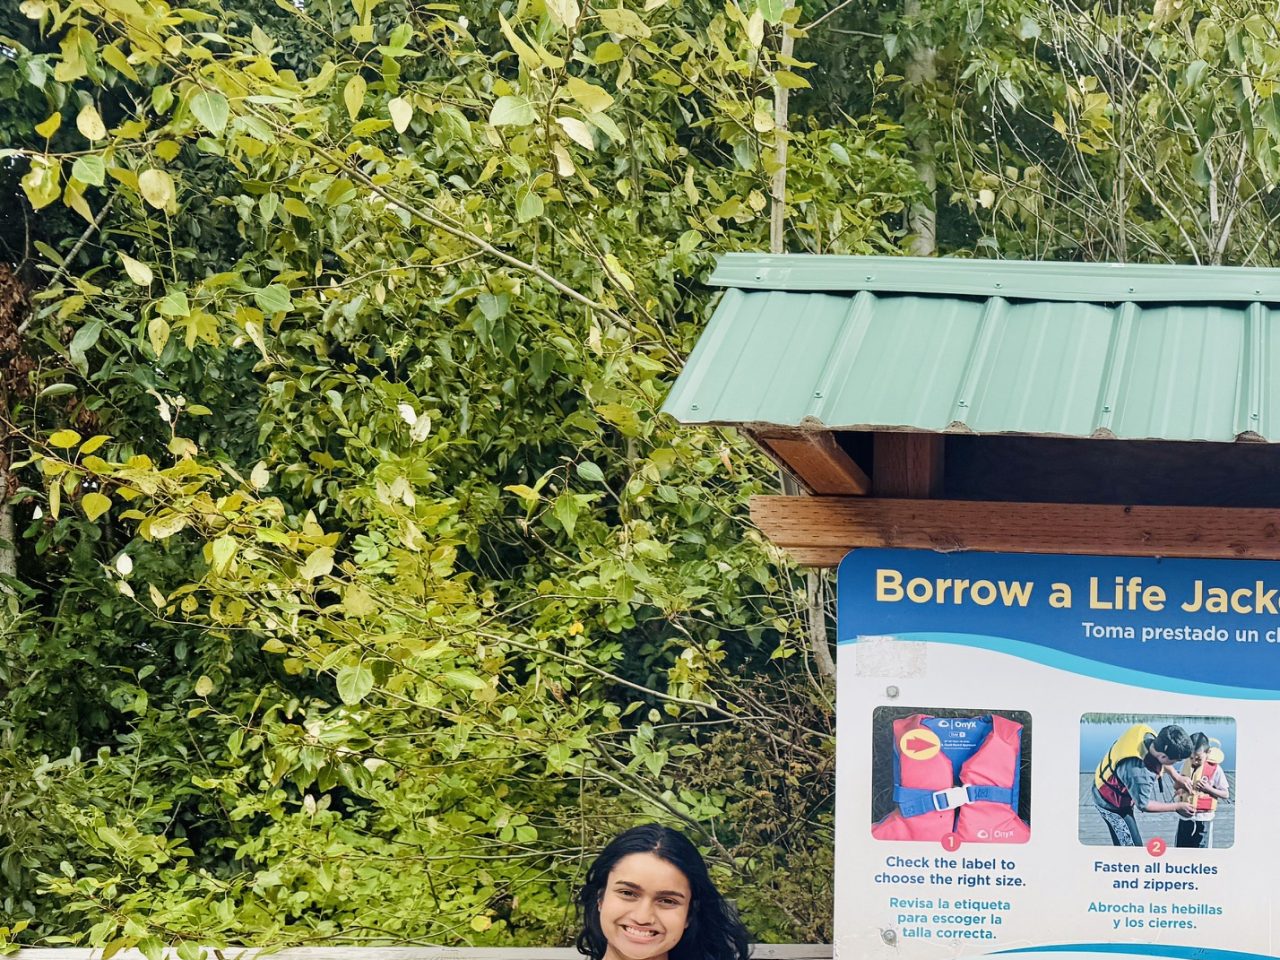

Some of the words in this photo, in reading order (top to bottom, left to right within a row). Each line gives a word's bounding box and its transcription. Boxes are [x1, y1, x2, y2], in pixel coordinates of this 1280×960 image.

[876, 569, 1033, 607] Borrow
[1049, 585, 1072, 609] a
[1090, 577, 1165, 612] Life
[1082, 622, 1135, 640] Toma
[1142, 625, 1229, 642] prestado
[1236, 629, 1259, 642] un
[954, 721, 976, 729] Onyx
[994, 829, 1014, 838] Onyx
[948, 836, 955, 847] 1
[1152, 841, 1161, 852] 2
[886, 857, 930, 869] Check
[935, 857, 957, 869] the
[962, 858, 996, 870] label
[1001, 860, 1015, 870] to
[1094, 862, 1140, 874] Fasten
[1144, 863, 1161, 873] all
[1165, 863, 1217, 875] buckles
[874, 873, 925, 885] choose
[930, 873, 954, 885] the
[958, 873, 991, 887] right
[996, 875, 1026, 887] size.
[1113, 879, 1139, 890] and
[1143, 878, 1199, 892] zippers.
[890, 898, 933, 910] Revisa
[938, 899, 949, 909] la
[954, 899, 1010, 913] etiqueta
[1088, 902, 1145, 914] Abrocha
[1149, 903, 1167, 914] las
[1171, 903, 1223, 915] hebillas
[898, 914, 928, 924] para
[932, 914, 986, 927] escoger
[991, 913, 1002, 924] la
[1113, 919, 1121, 930] y
[1124, 917, 1144, 928] los
[1148, 918, 1197, 929] cierres.
[903, 927, 932, 938] talla
[936, 928, 997, 939] correcta.
